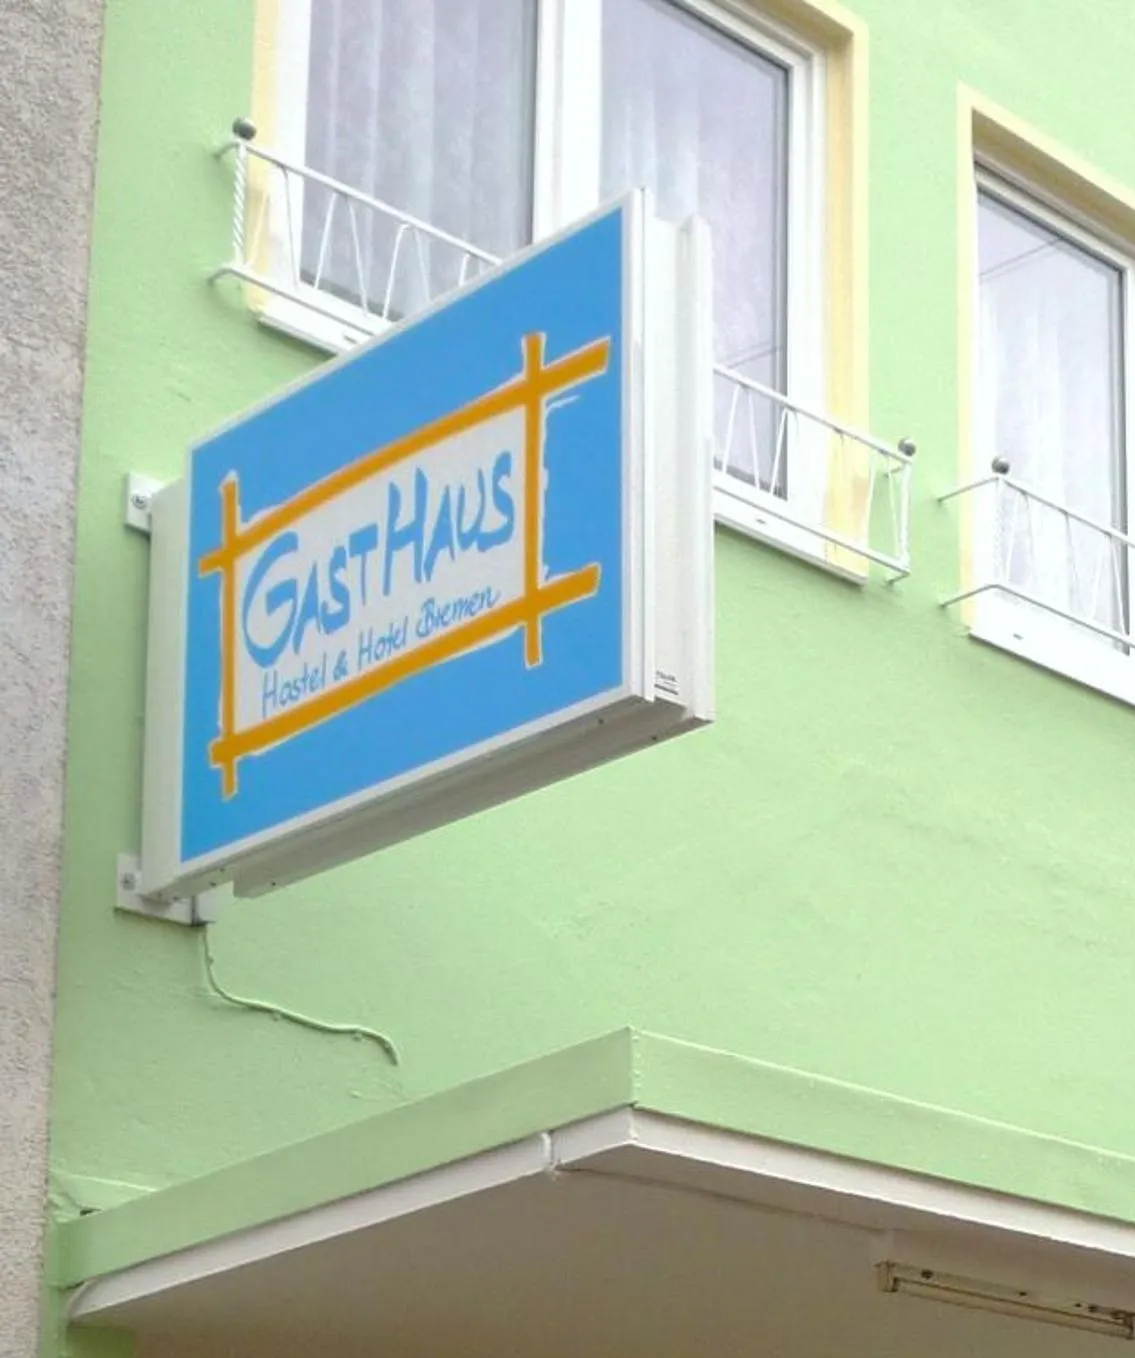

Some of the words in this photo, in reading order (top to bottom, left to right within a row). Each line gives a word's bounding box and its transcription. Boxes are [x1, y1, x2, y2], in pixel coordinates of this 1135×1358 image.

[242, 450, 516, 668] GASTHAUS
[262, 652, 328, 718] Hostel
[332, 650, 349, 682] &
[357, 614, 409, 671] Hotel
[415, 585, 502, 639] Bremen
